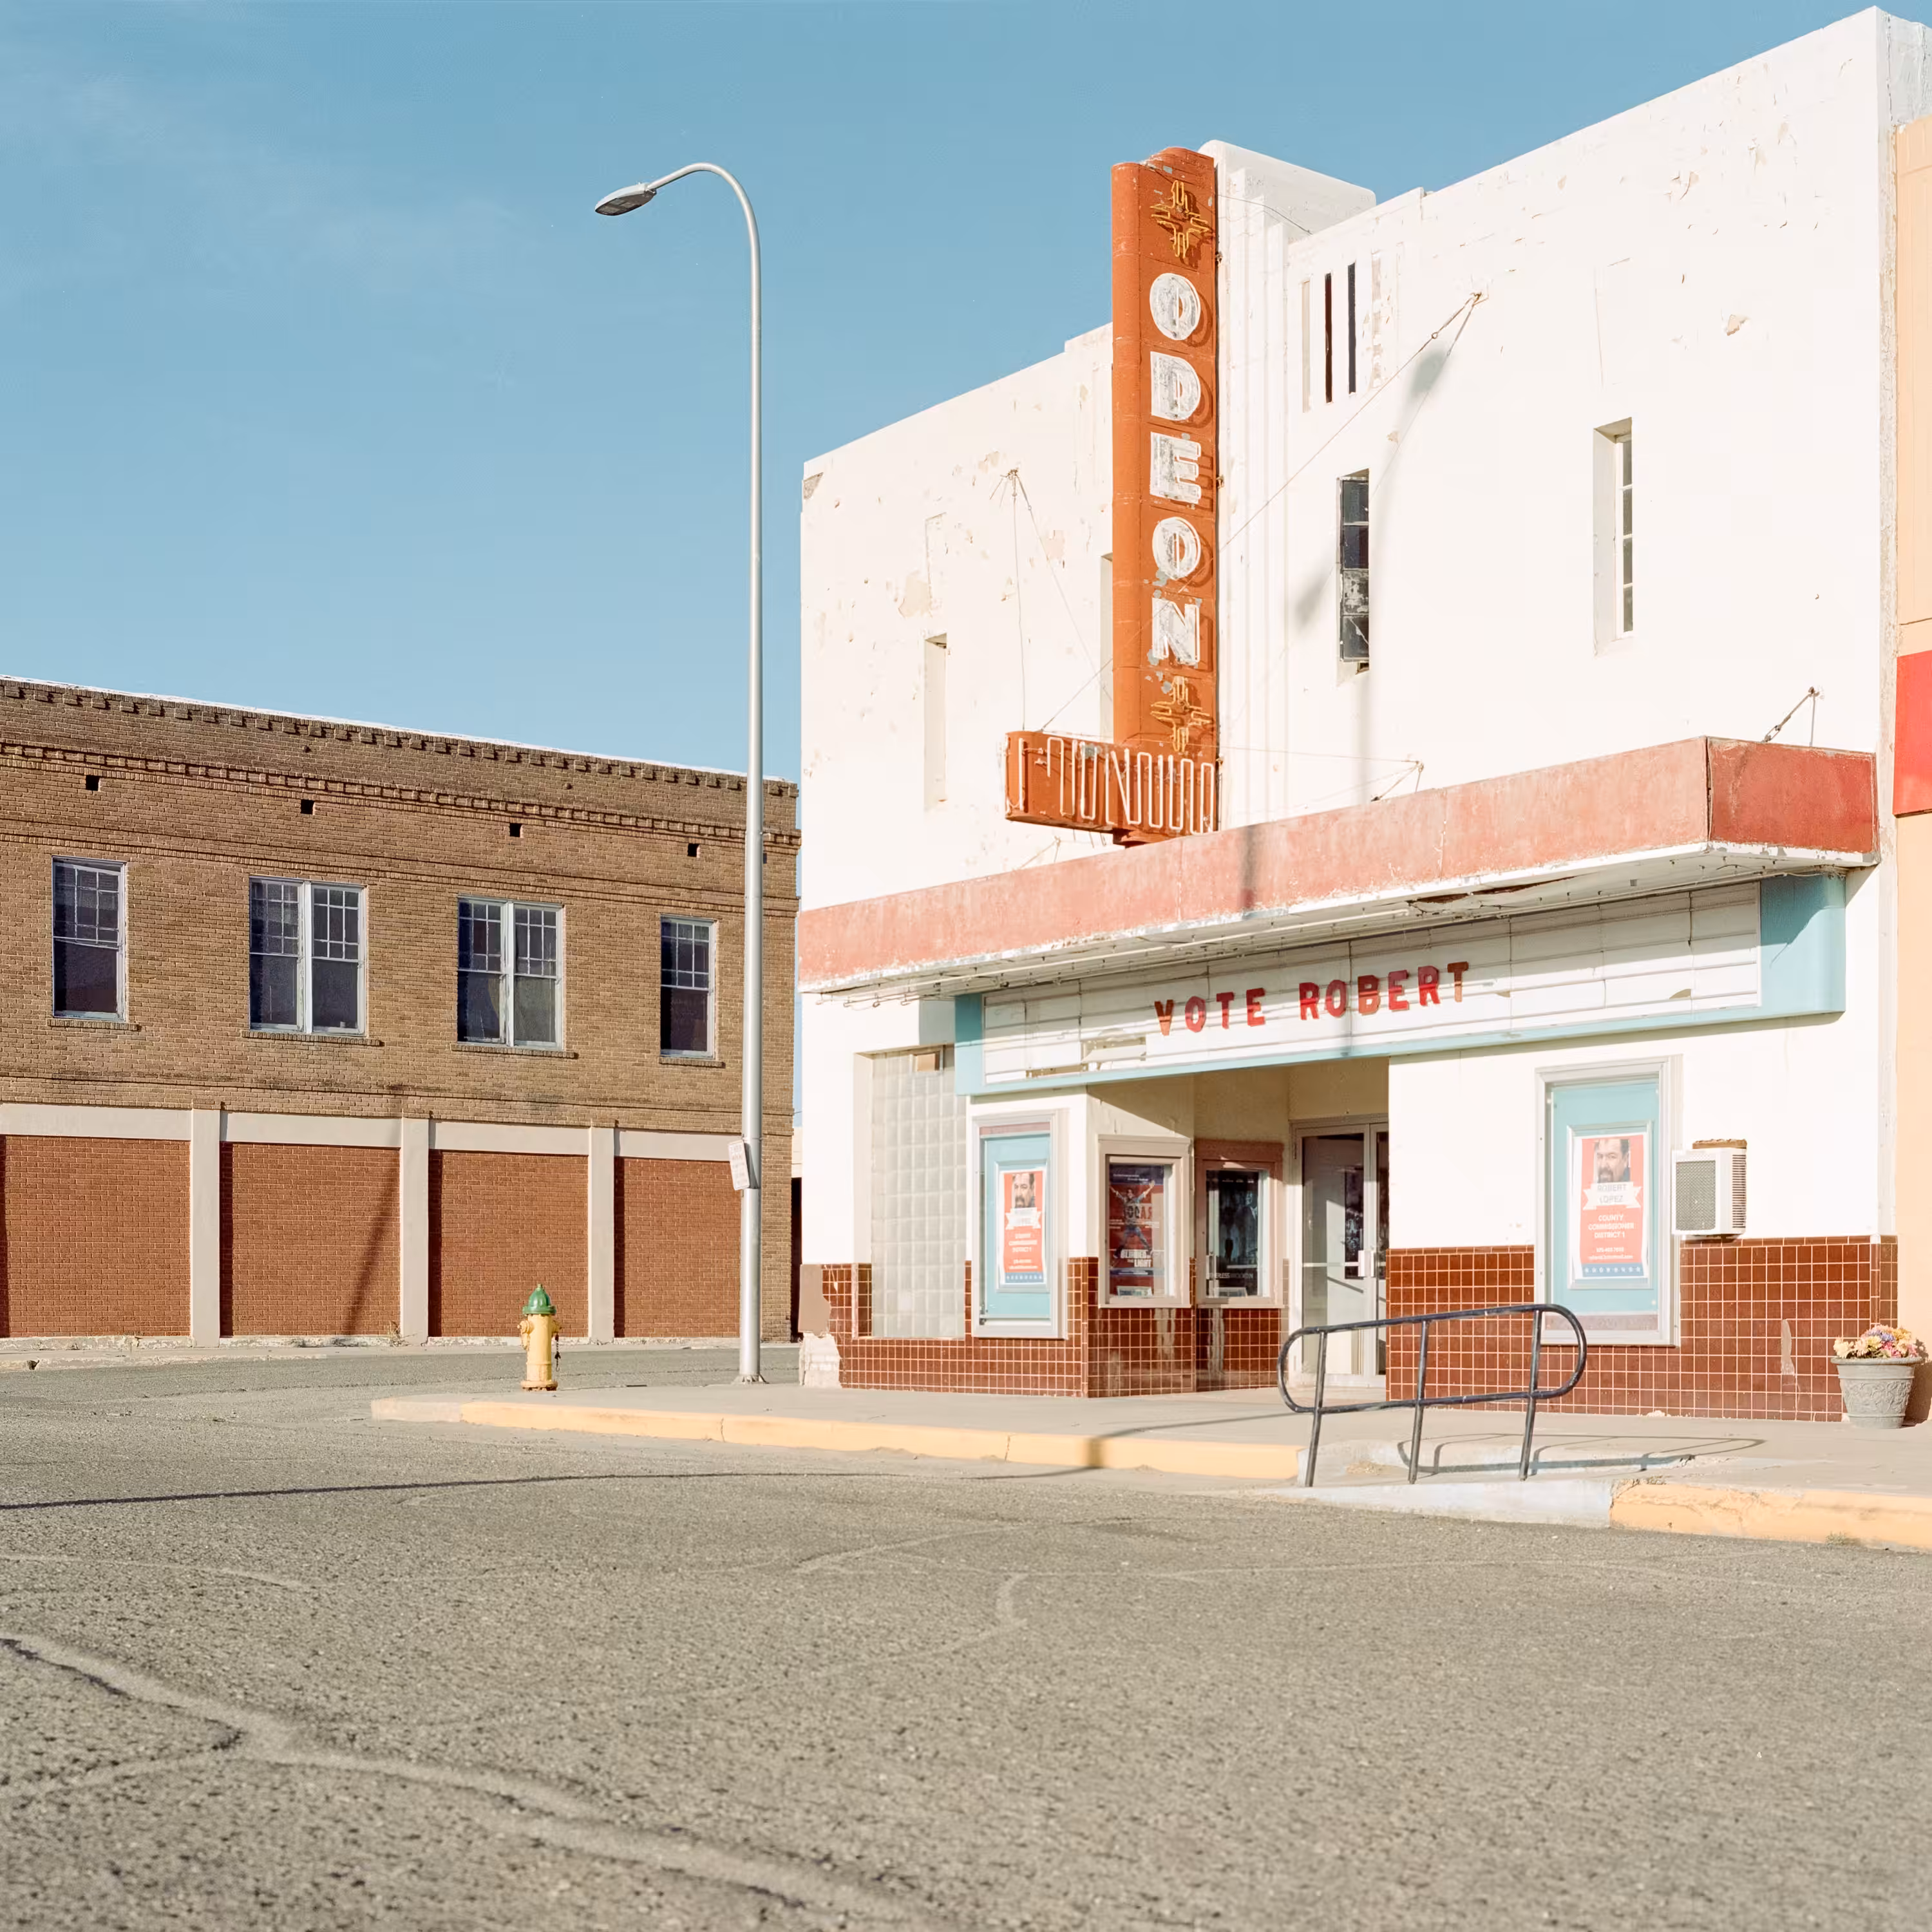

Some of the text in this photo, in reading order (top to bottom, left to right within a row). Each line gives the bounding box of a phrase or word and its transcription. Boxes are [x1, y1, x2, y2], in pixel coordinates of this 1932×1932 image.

[1149, 272, 1202, 668] ODEON
[1154, 961, 1469, 1036] VOTE ROBERT
